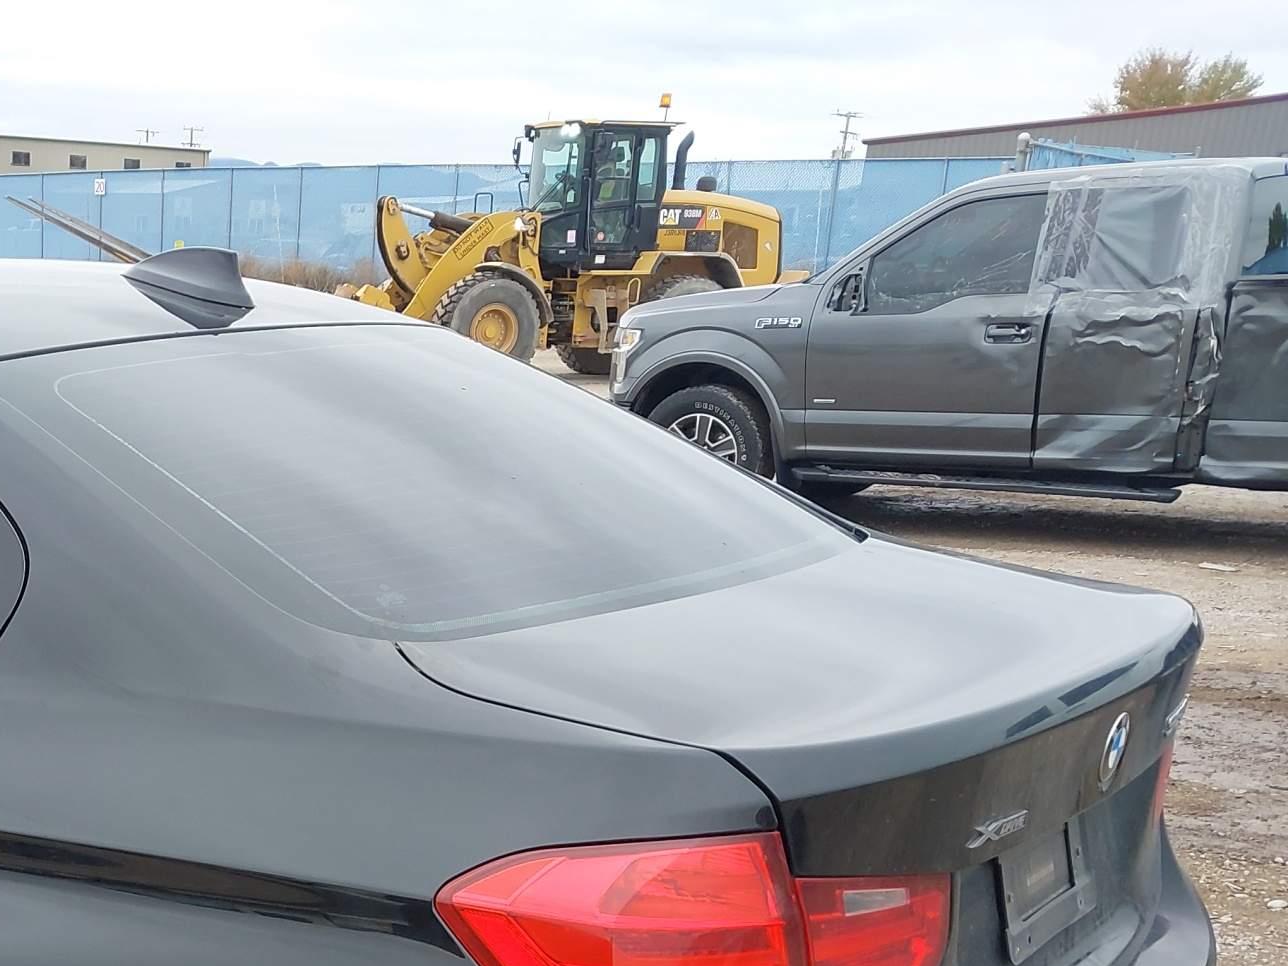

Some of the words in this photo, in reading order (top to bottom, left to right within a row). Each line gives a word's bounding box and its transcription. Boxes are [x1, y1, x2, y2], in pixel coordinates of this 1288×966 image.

[95, 180, 105, 193] 20
[659, 208, 681, 225] CAT
[684, 209, 702, 218] 938M
